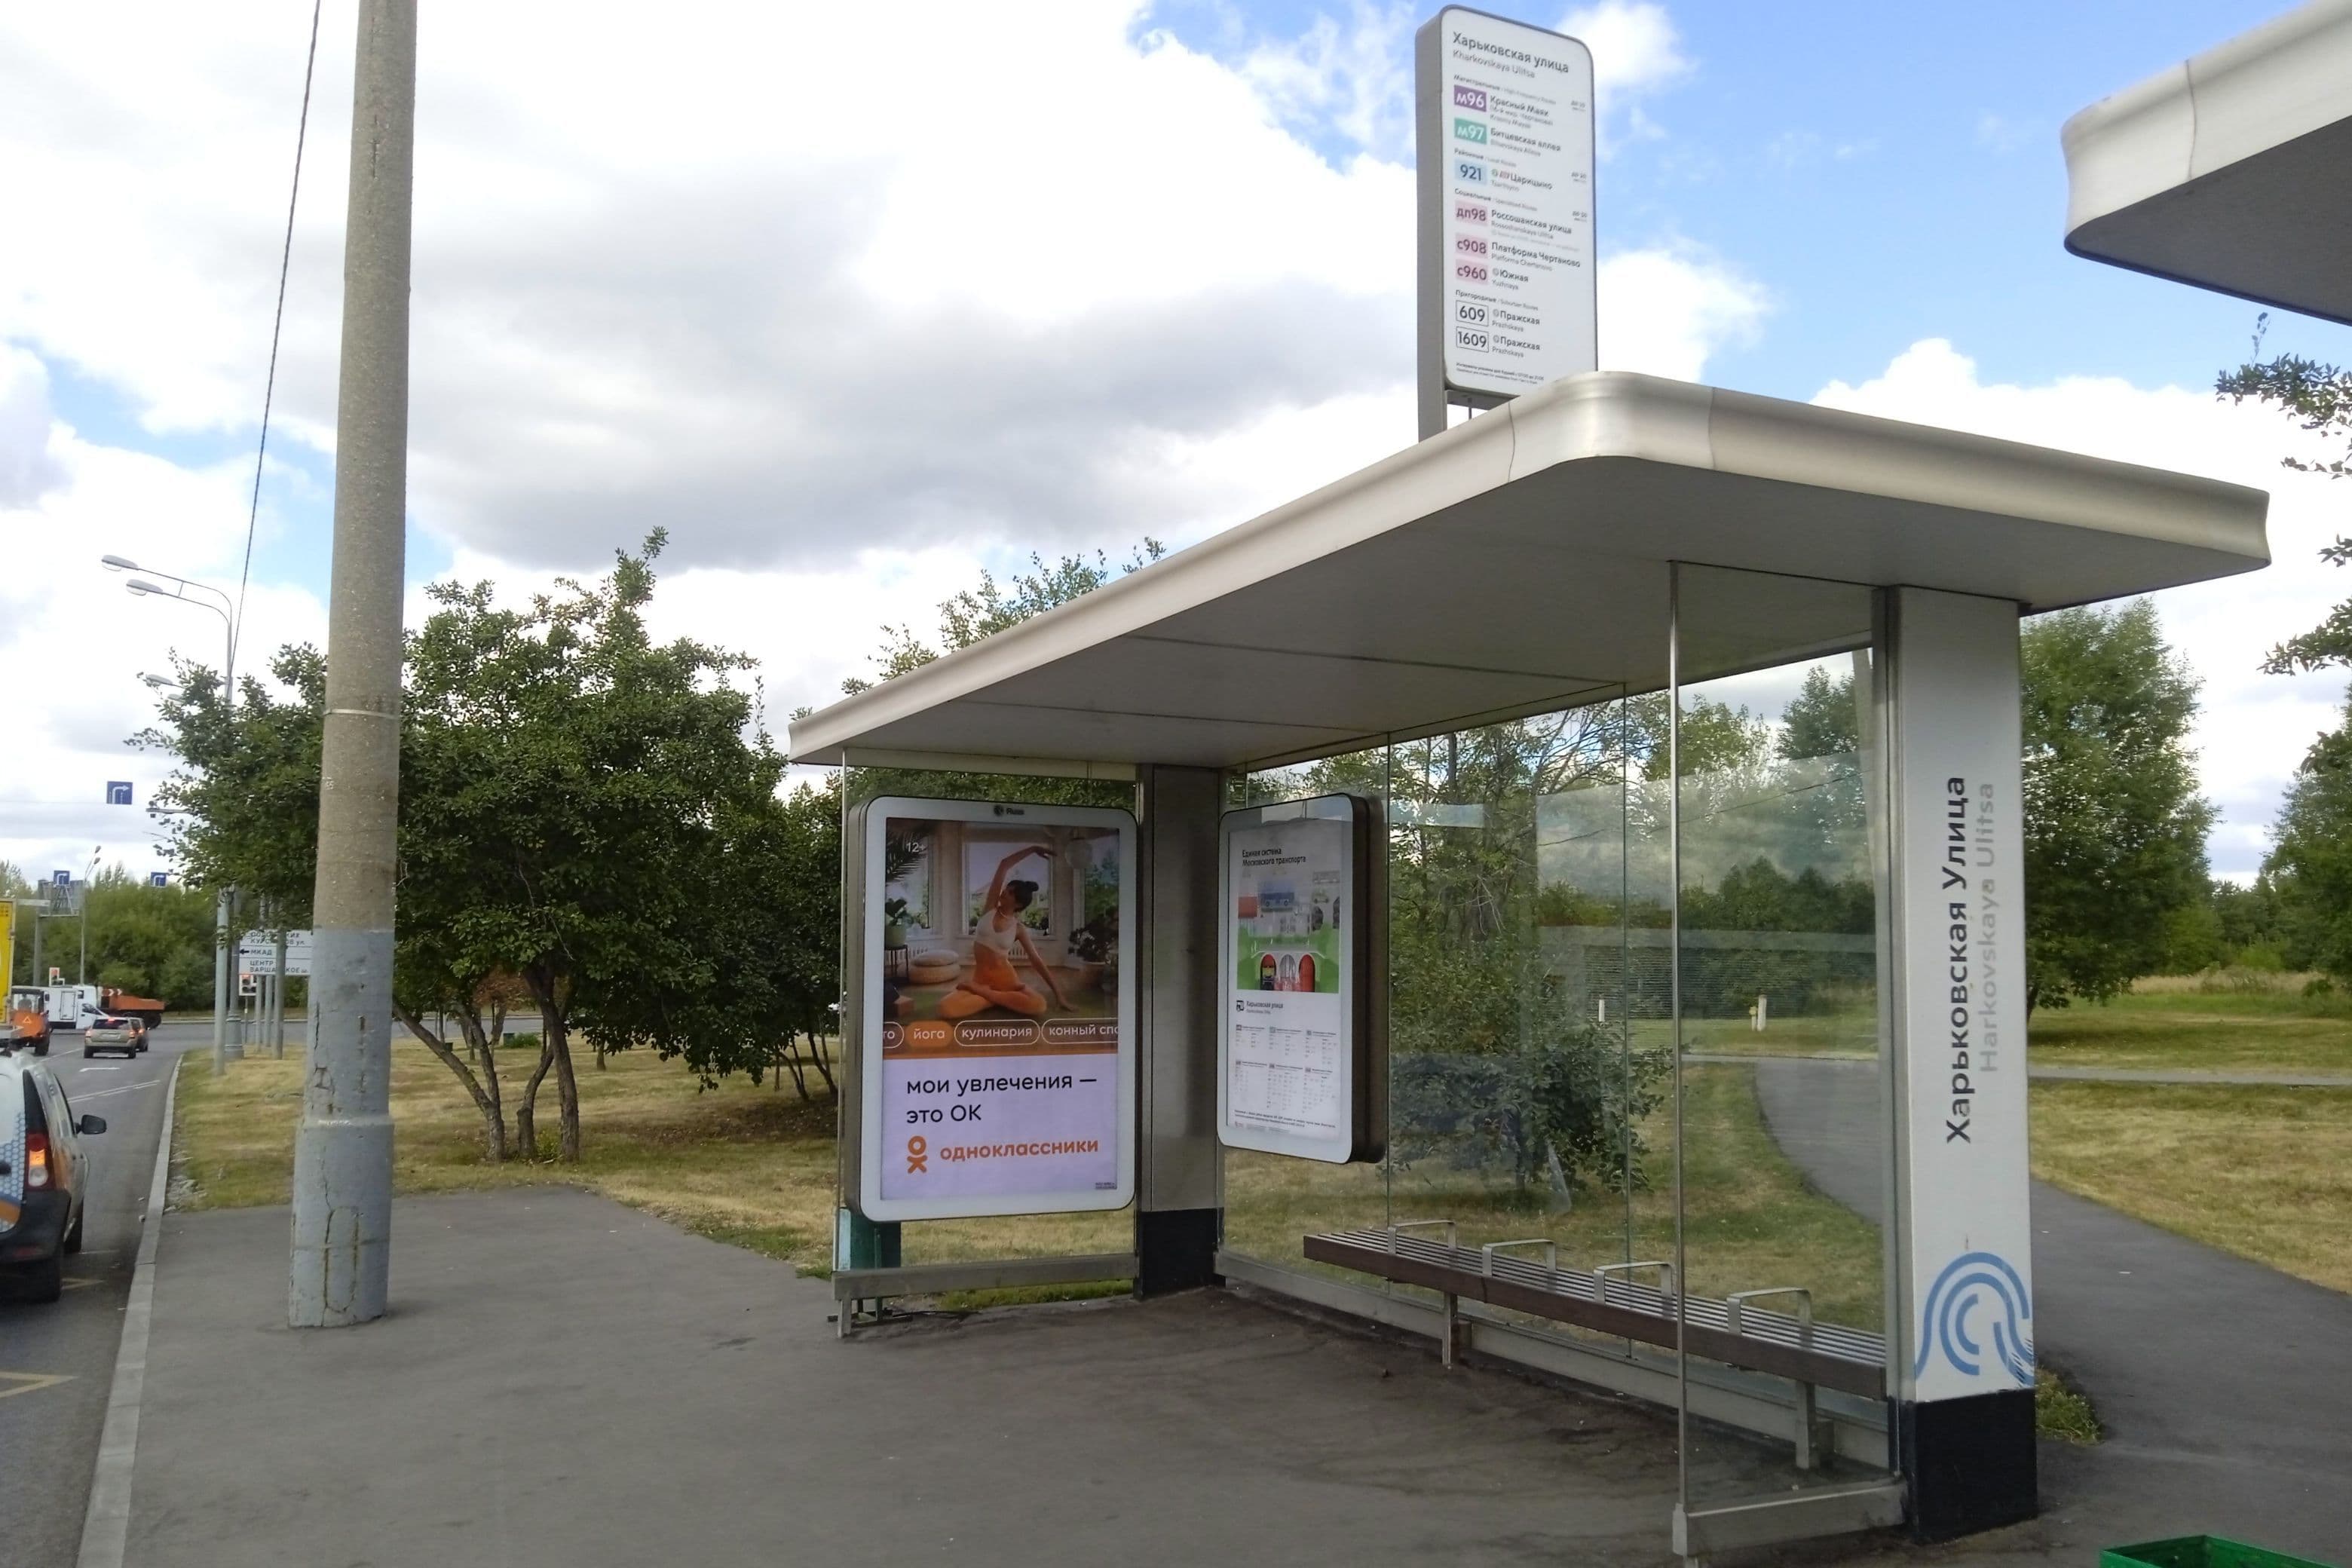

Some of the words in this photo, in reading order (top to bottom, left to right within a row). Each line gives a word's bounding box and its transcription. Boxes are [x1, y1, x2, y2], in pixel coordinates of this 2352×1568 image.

[1453, 32, 1531, 63] Харьковская
[1534, 57, 1569, 73] улица
[1460, 164, 1481, 181] 921
[1457, 239, 1487, 254] с908
[1492, 242, 1537, 259] Платформа
[1539, 252, 1580, 268] Чертаново
[1457, 265, 1487, 280] с960
[1500, 268, 1529, 283] Южная
[1459, 306, 1485, 322] 609
[1500, 311, 1540, 325] Пражская
[1458, 332, 1487, 348] 1609
[1501, 336, 1540, 351] Пражская
[1975, 782, 1995, 868] Ulitsa
[1942, 777, 1968, 890] Улица
[906, 842, 926, 852] 12+
[1975, 878, 1999, 1072] Harkovskaya
[1049, 1024, 1096, 1036] конный
[1946, 902, 1975, 1144] Харьковская
[914, 1028, 945, 1040] йога
[962, 1026, 1032, 1040] кулинария
[907, 1080, 949, 1094] мои
[957, 1075, 1072, 1097] увлечения
[907, 1109, 943, 1123] это
[951, 1104, 982, 1122] ОК
[940, 1140, 1098, 1162] одноклассники
